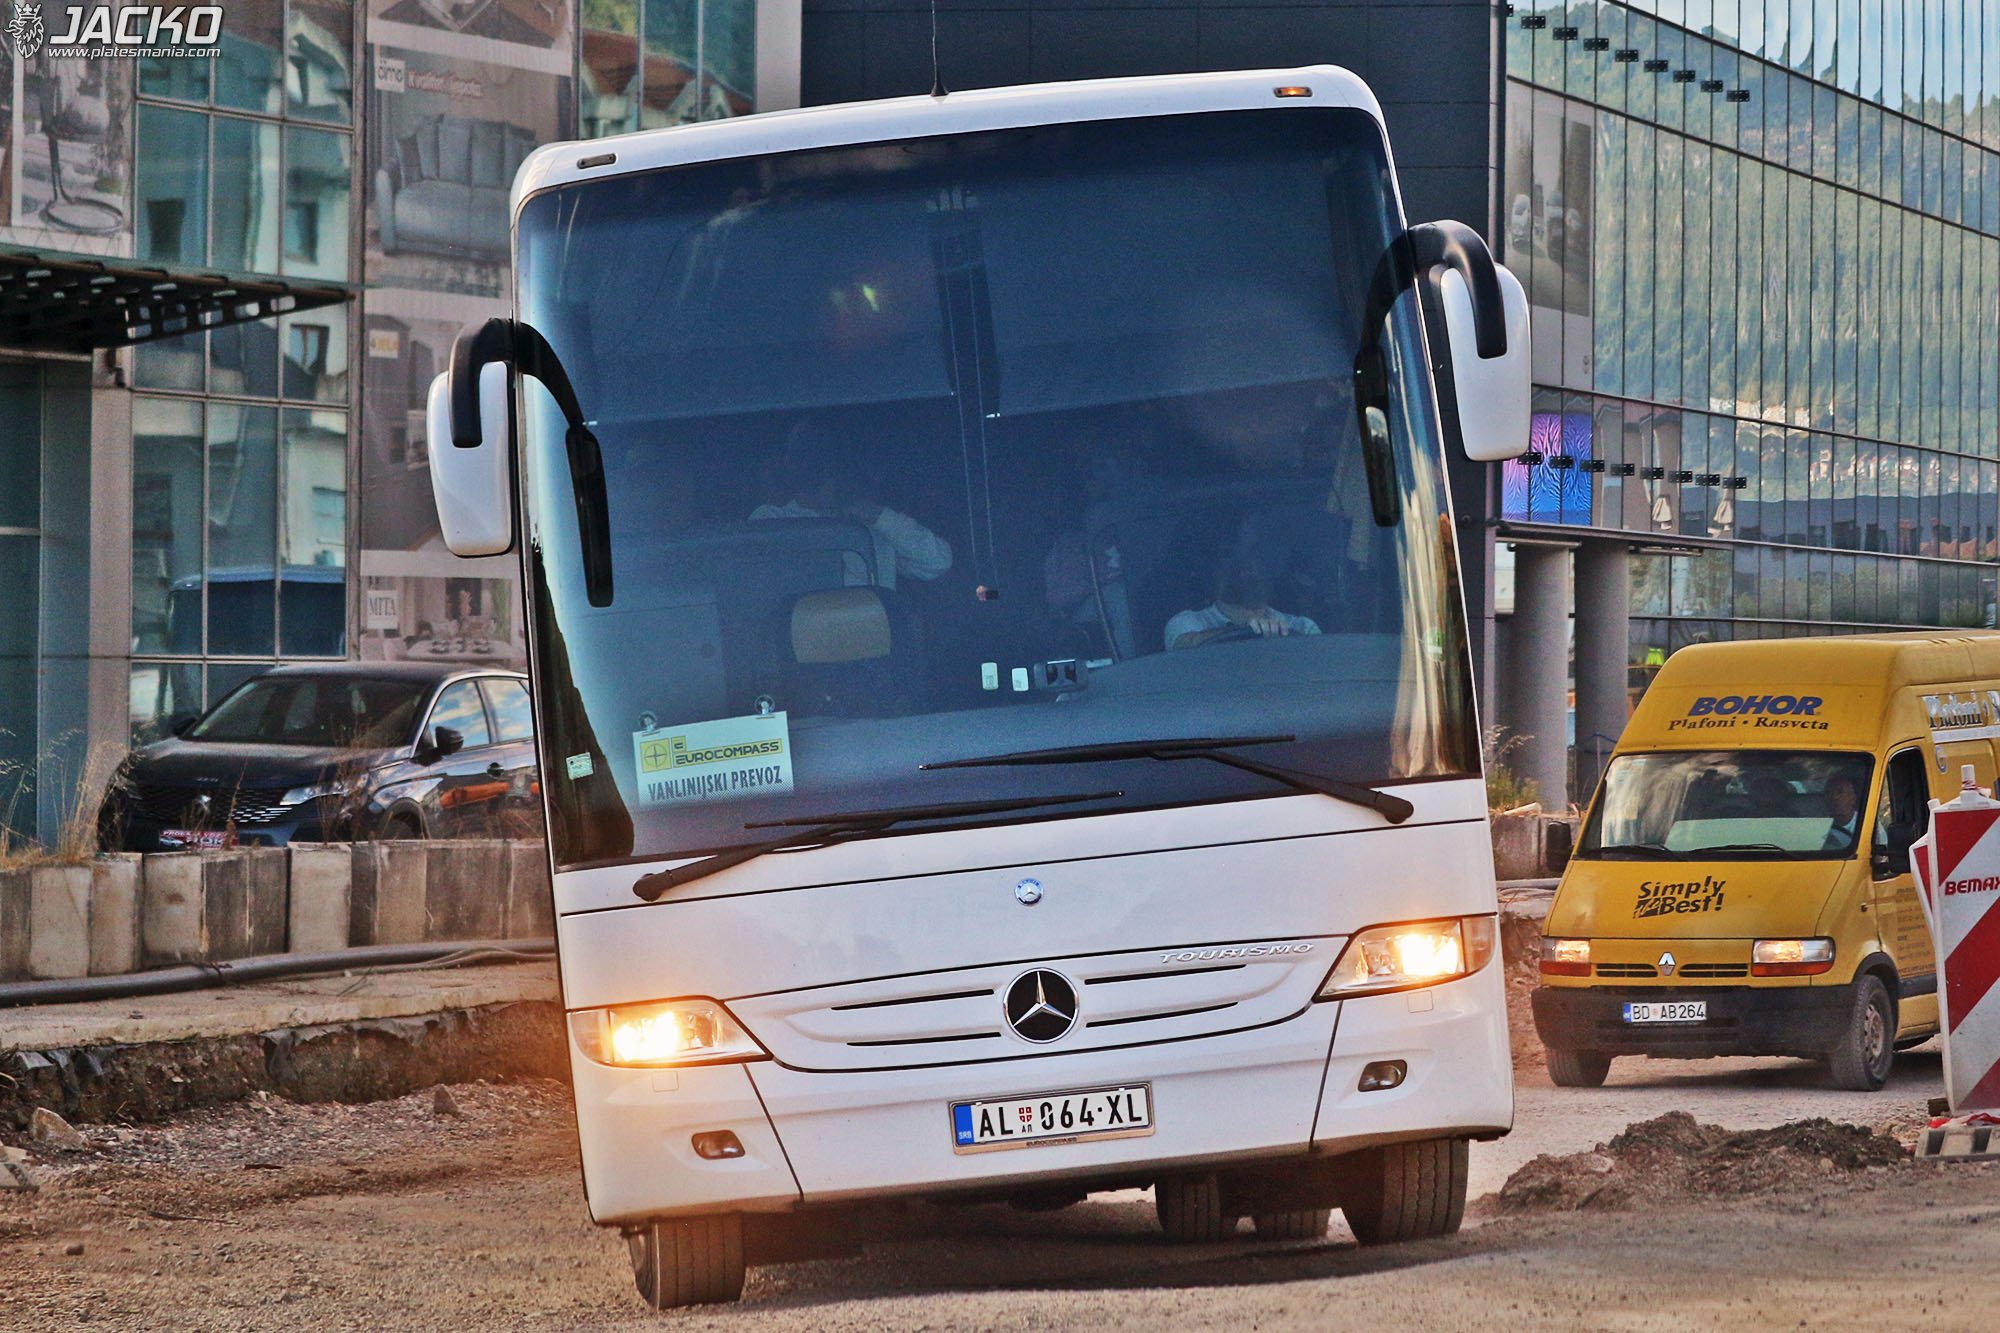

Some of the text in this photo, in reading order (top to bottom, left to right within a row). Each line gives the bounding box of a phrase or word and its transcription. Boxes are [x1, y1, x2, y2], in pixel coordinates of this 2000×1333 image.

[1688, 695, 1823, 716] BOHOR
[1668, 716, 1736, 731] Plafoni
[676, 741, 779, 765] EUROCOMPASS
[648, 765, 782, 801] VANLINIJSKI PREVOZ
[1659, 893, 1724, 916] Best!
[1159, 943, 1314, 963] TOURISMO
[1632, 1004, 1705, 1020] BD AB264
[979, 1107, 1014, 1138] AL
